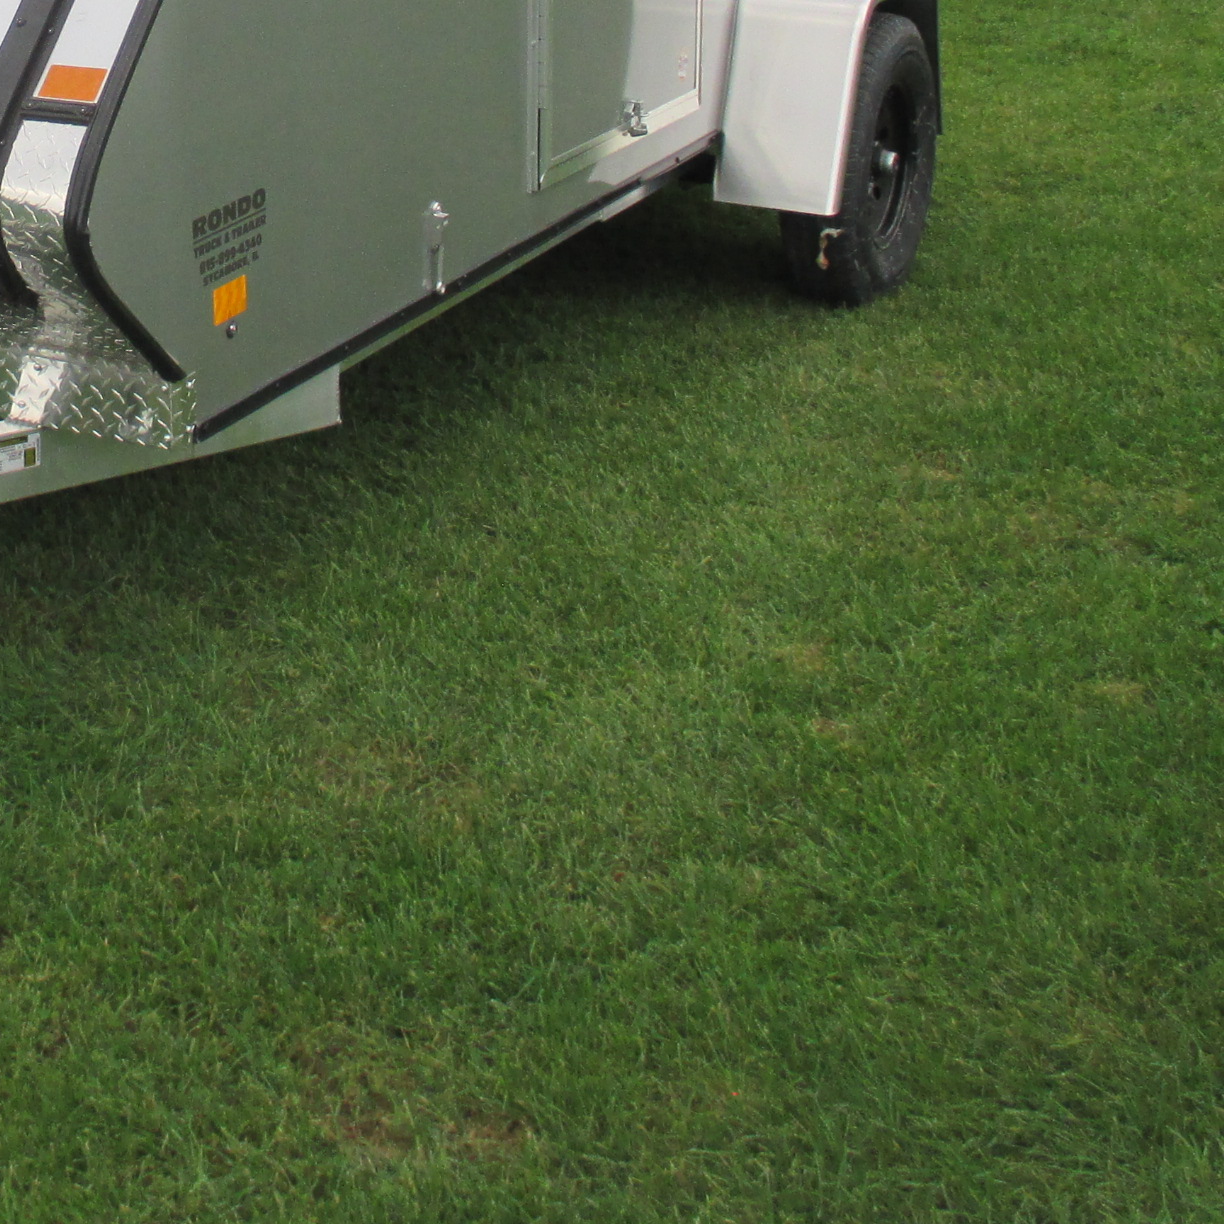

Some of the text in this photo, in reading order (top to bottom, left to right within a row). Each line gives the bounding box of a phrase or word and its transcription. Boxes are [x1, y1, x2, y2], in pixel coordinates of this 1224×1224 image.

[192, 187, 266, 240] RONDO
[194, 235, 222, 259] TRUCK
[232, 214, 267, 242] TRAILER
